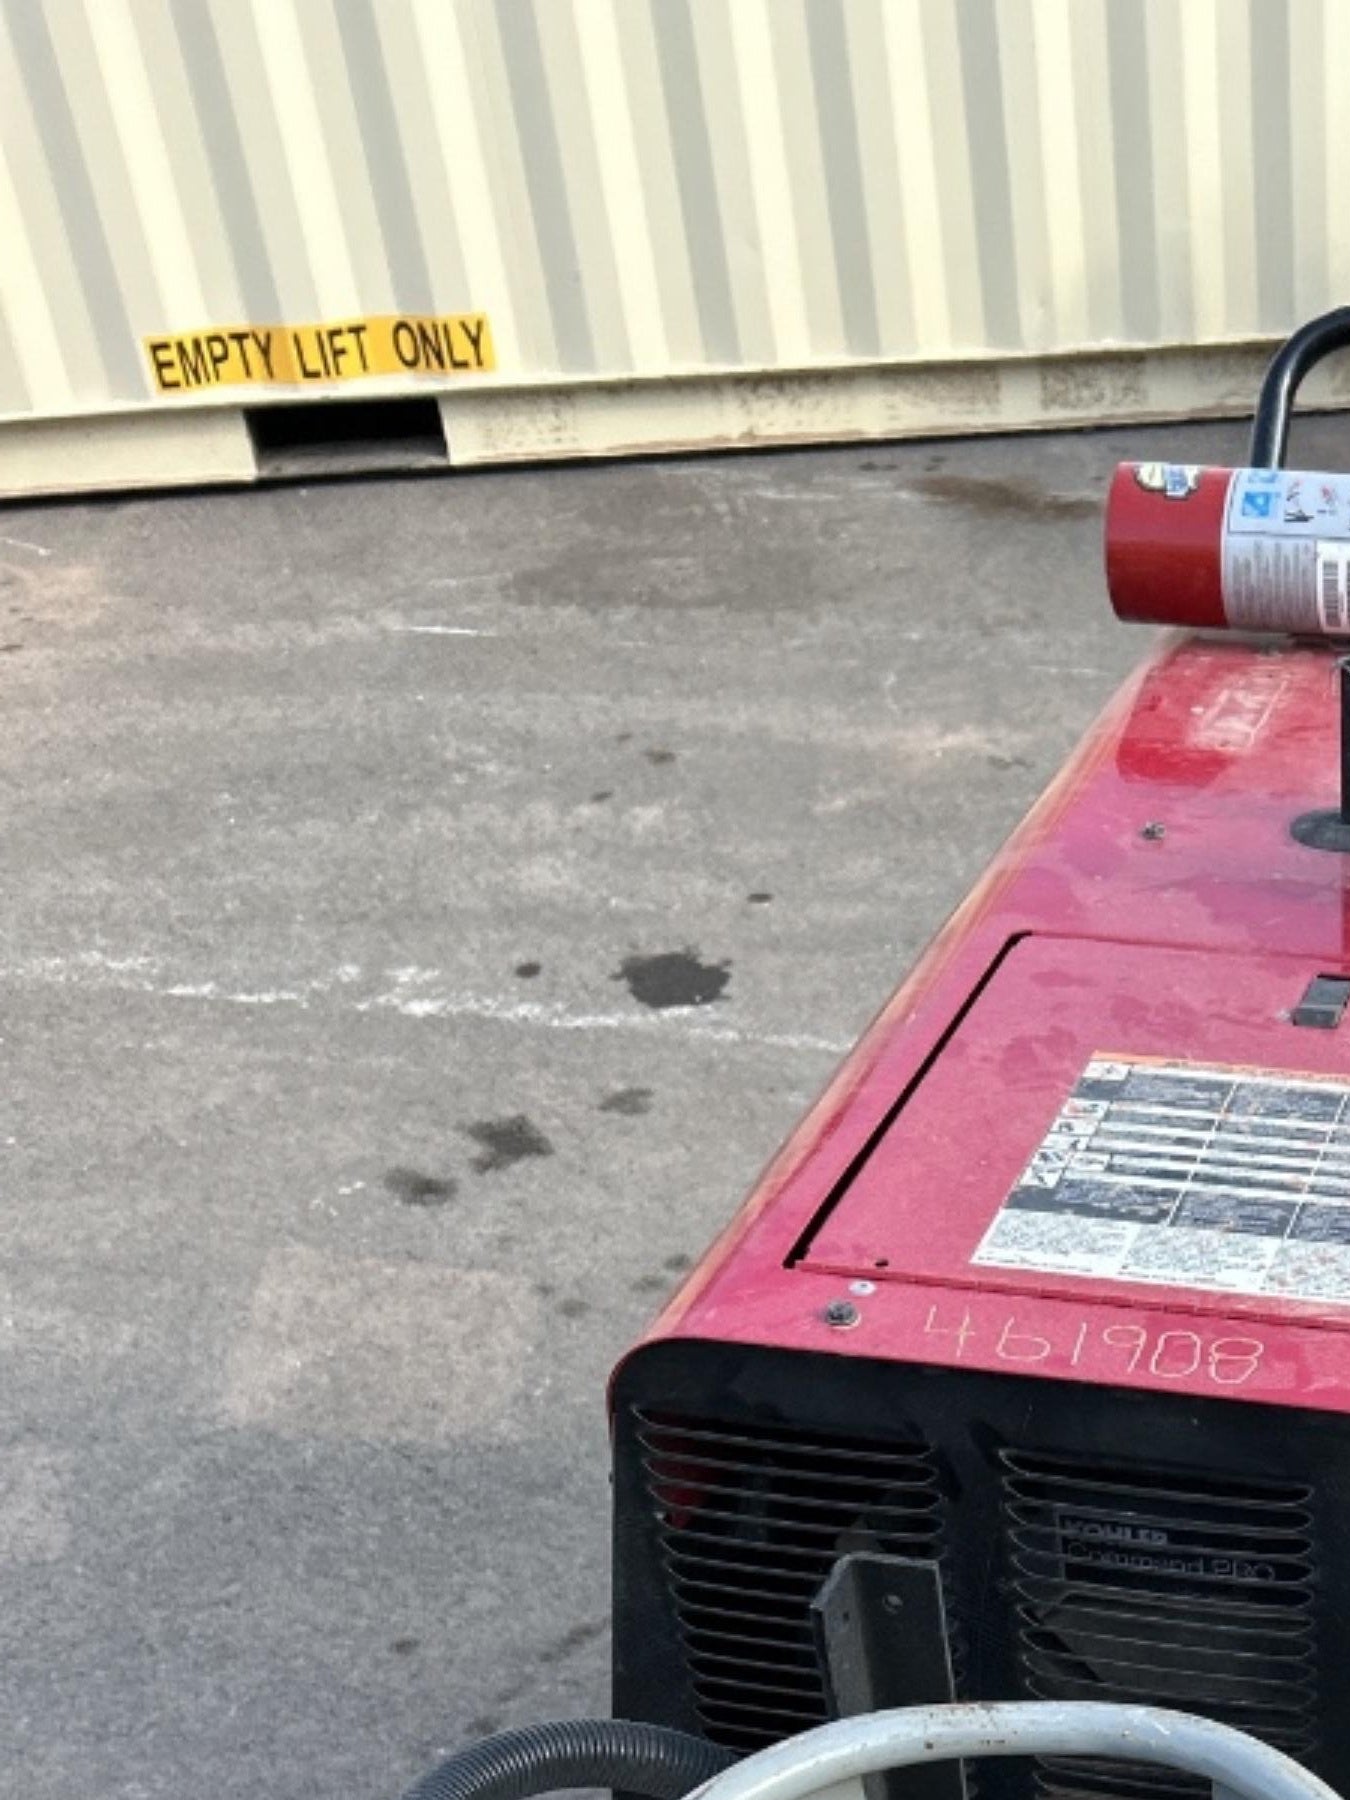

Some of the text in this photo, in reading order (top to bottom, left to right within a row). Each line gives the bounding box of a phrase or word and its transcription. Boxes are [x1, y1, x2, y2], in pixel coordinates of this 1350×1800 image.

[149, 319, 485, 389] EMPTY LIFT ONLY
[924, 1304, 1265, 1385] 461908
